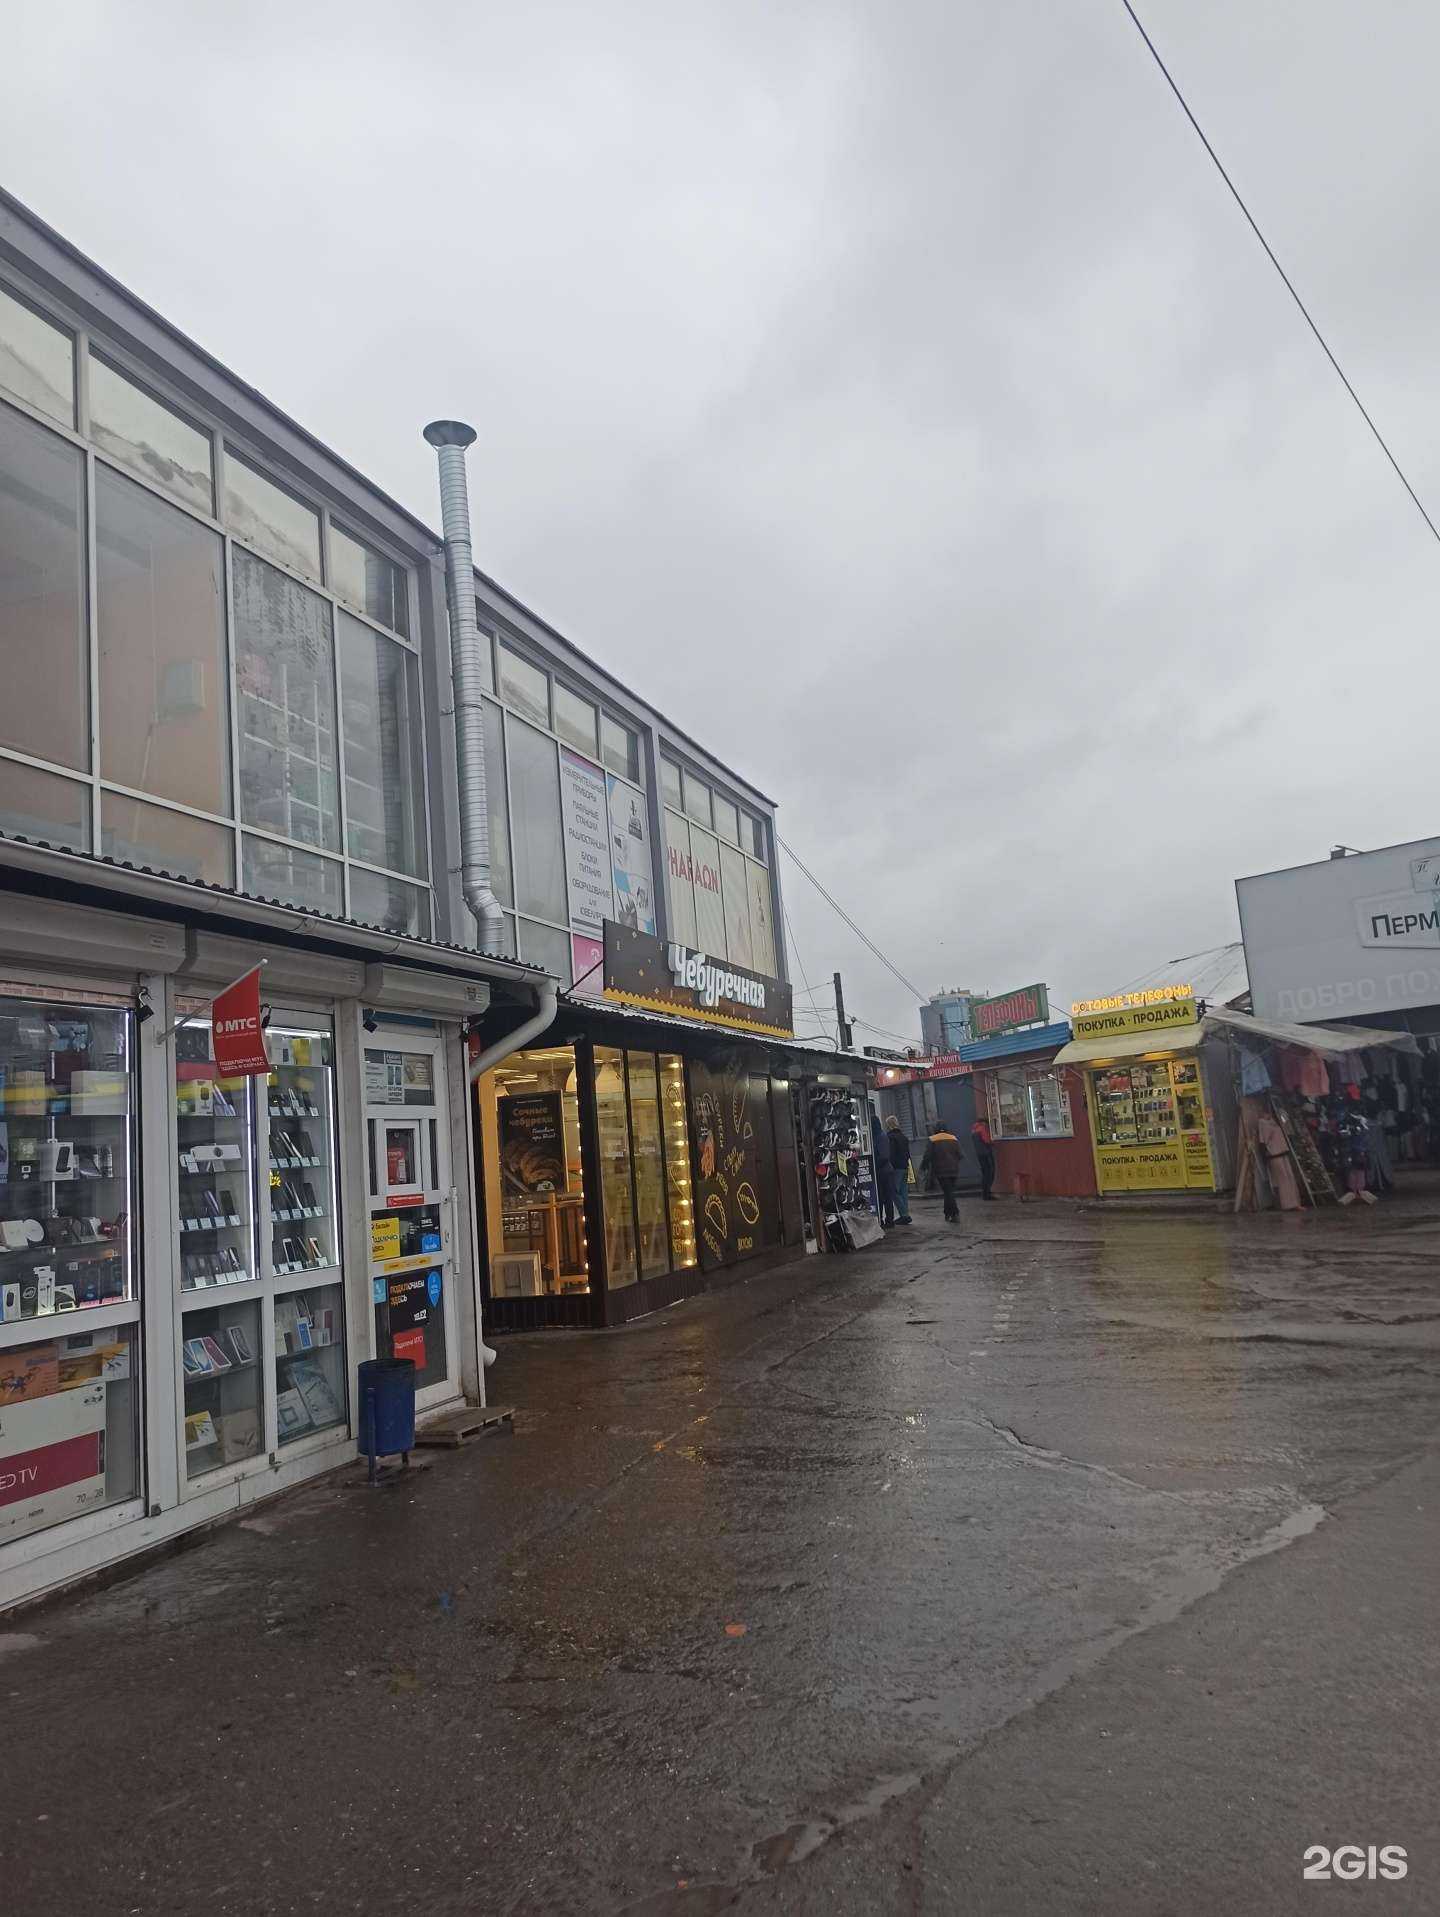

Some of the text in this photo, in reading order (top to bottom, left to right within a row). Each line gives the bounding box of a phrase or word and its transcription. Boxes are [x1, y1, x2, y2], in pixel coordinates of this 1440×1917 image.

[668, 943, 766, 1008] Чебуречная
[1072, 984, 1193, 1014] СОТОВЫЕ ТЕЛЕФОНЫ
[225, 1016, 257, 1033] МТС
[1077, 1006, 1190, 1033] ПОКУПКА ПРОДАЖА
[1102, 1153, 1178, 1166] ПОКУПКА ПРОДАЖА
[19, 1465, 38, 1484] TV
